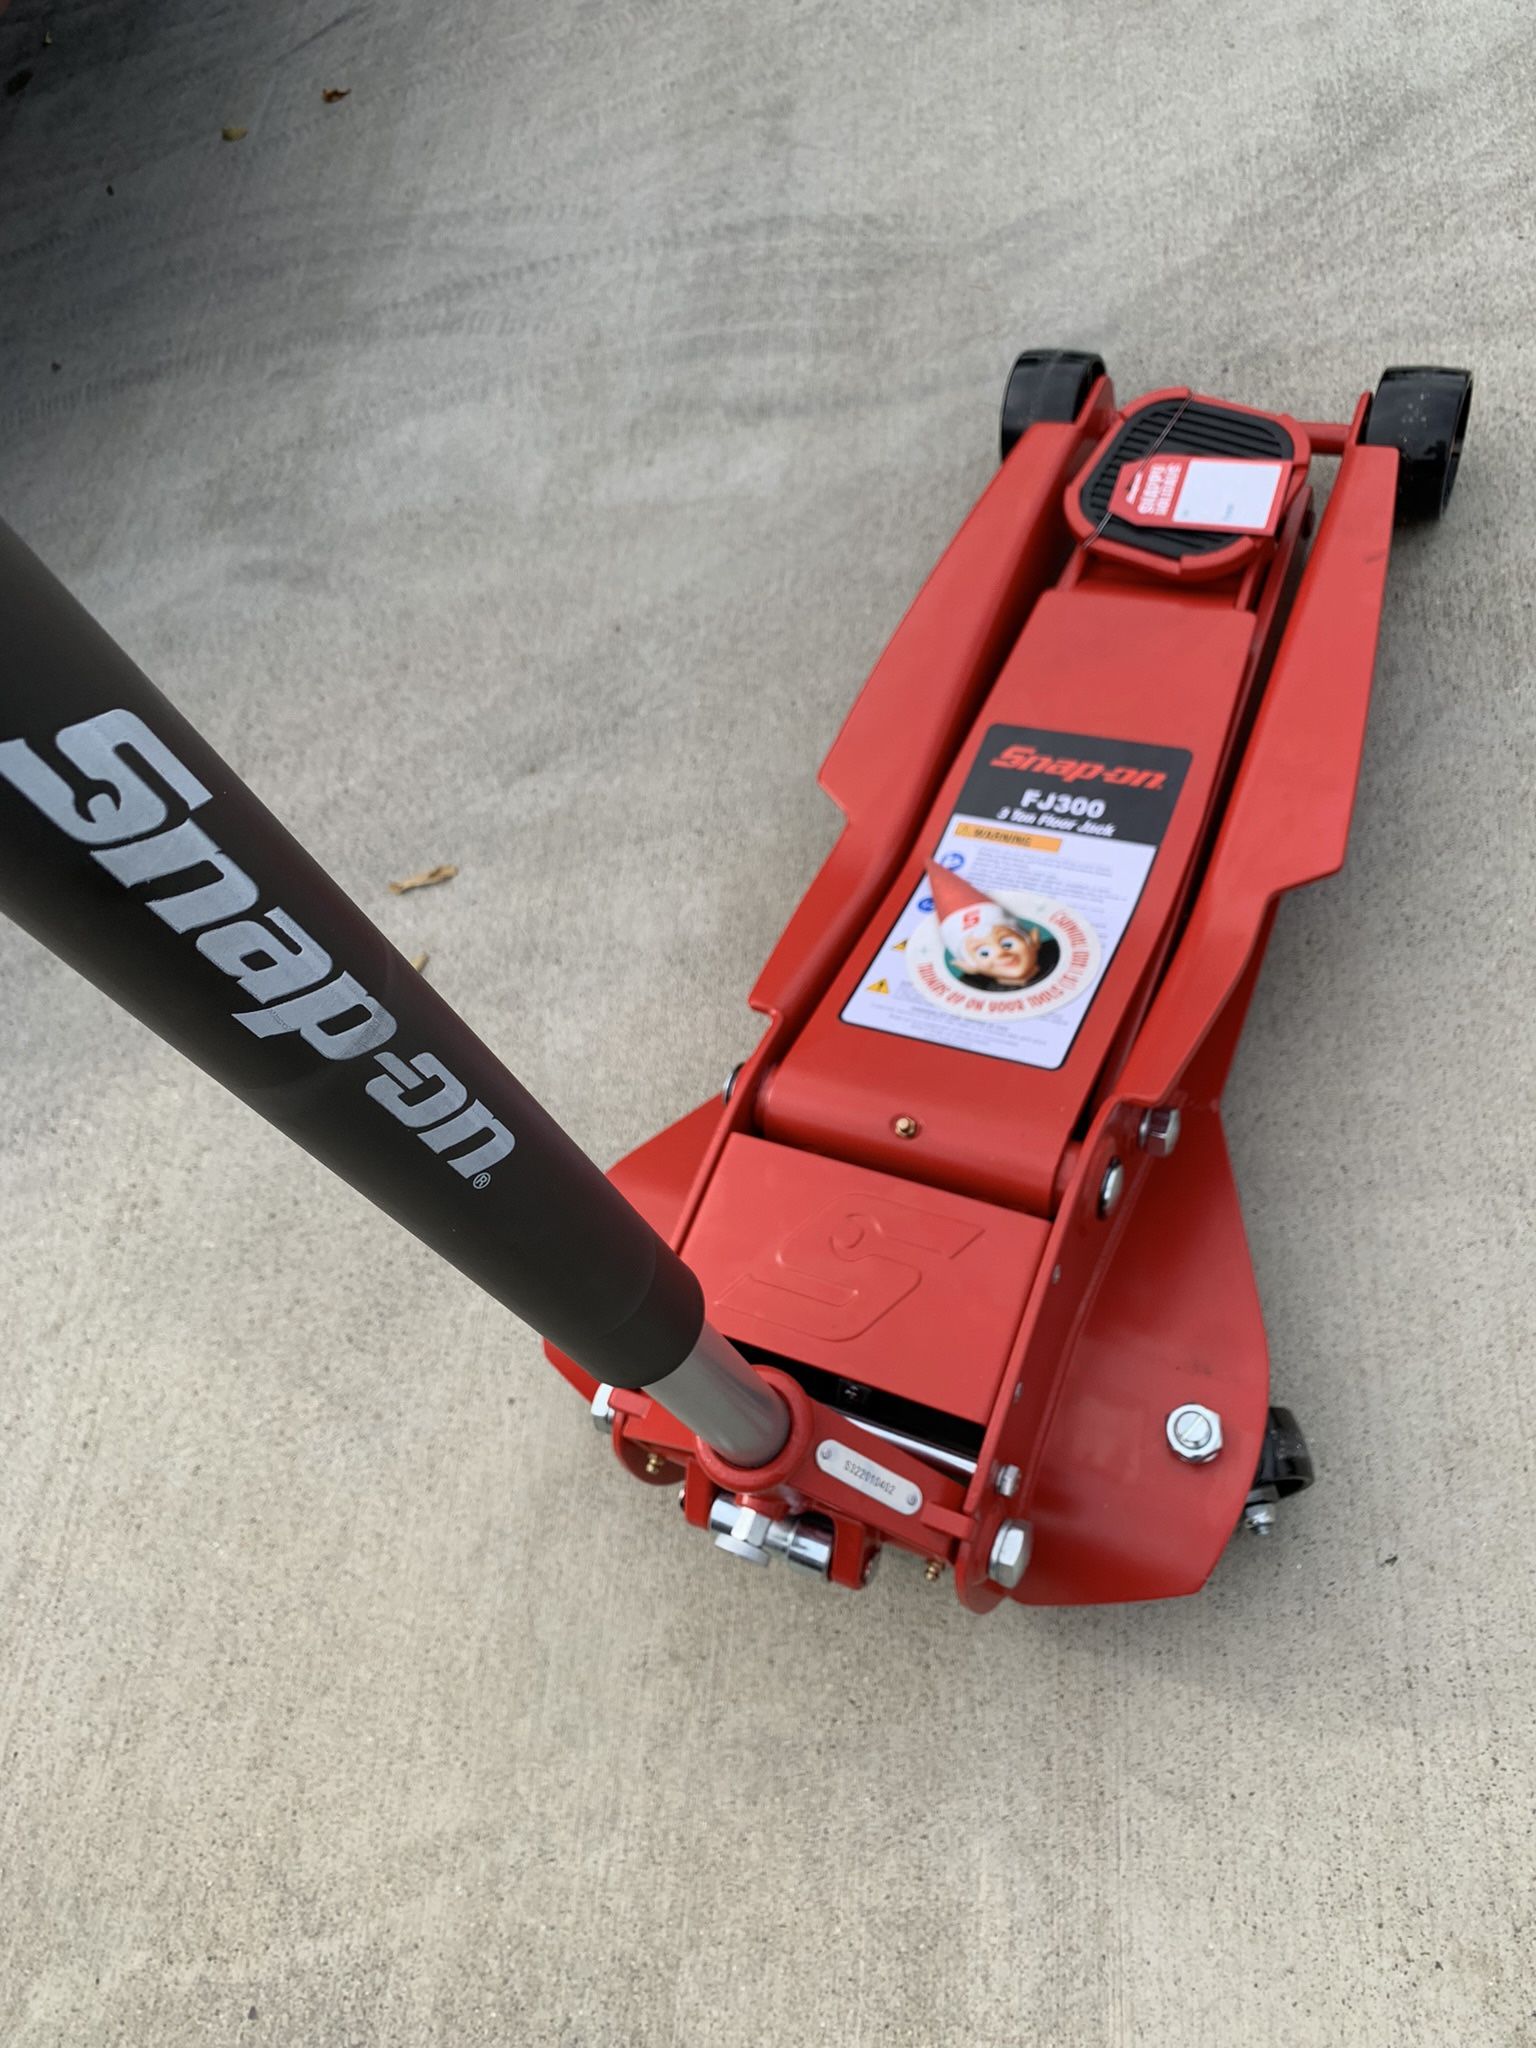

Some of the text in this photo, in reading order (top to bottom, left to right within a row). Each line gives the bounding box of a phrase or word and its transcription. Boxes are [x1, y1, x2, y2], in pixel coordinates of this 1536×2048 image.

[990, 744, 1168, 789] Snap-on
[1020, 788, 1106, 819] FJ300
[974, 828, 1032, 846] WARNING
[997, 806, 1117, 837] 3 Ton Floor Jack
[965, 1000, 984, 1011] ON
[988, 1000, 1025, 1012] YOUR
